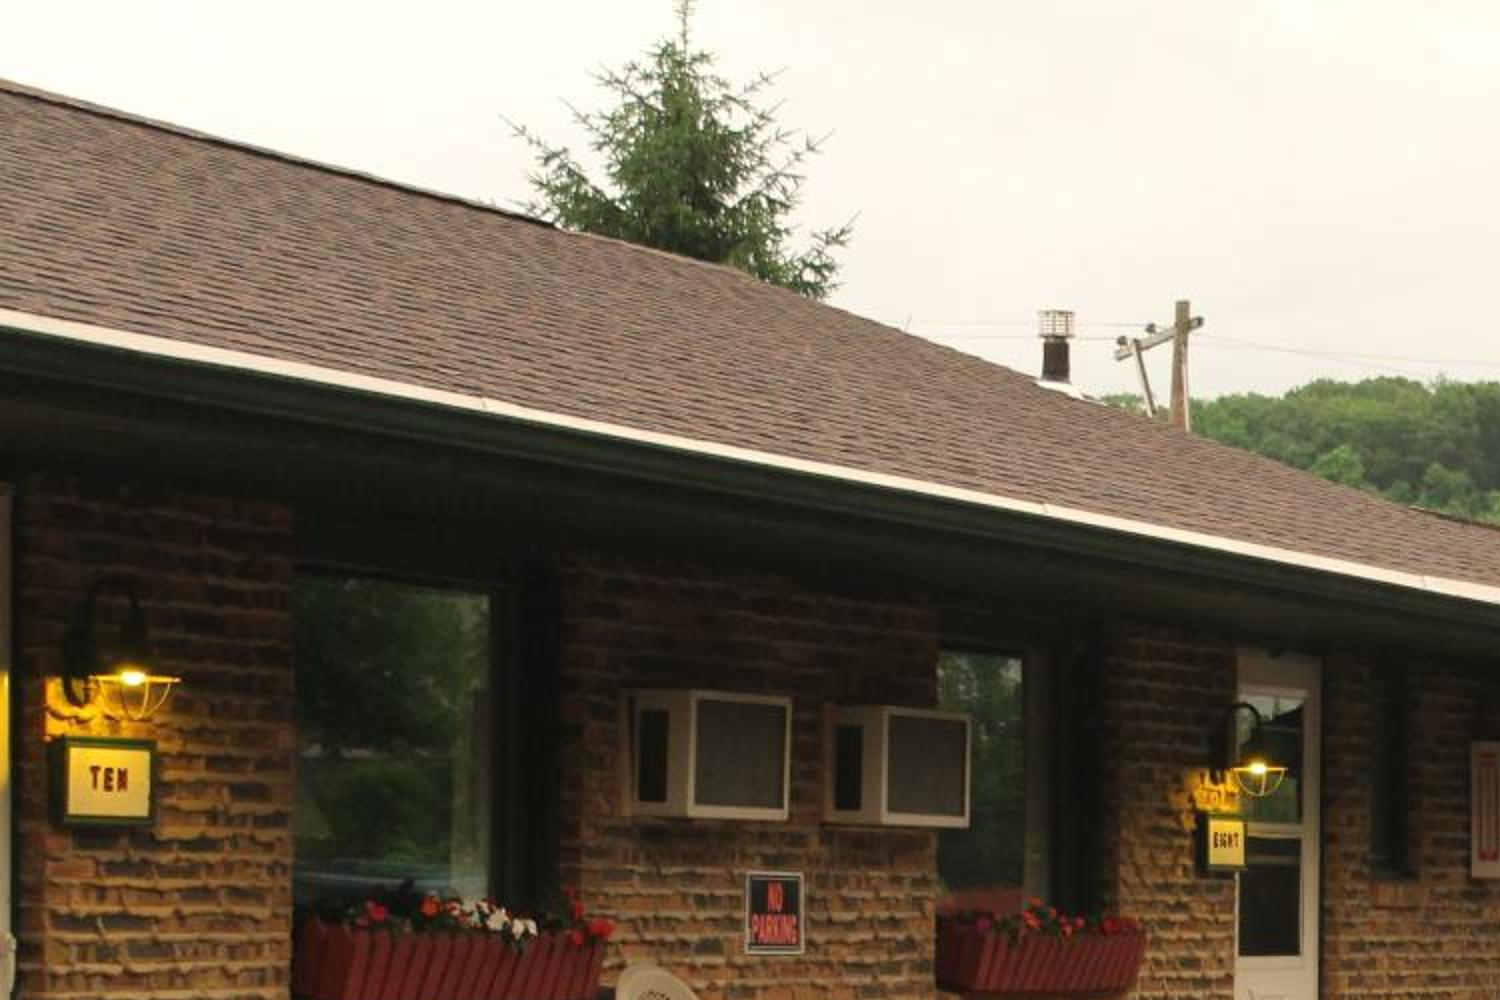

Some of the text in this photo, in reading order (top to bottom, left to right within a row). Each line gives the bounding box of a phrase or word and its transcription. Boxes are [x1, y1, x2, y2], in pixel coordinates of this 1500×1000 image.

[89, 764, 129, 793] TEN
[767, 880, 784, 912] NO
[751, 912, 799, 944] PARKING
